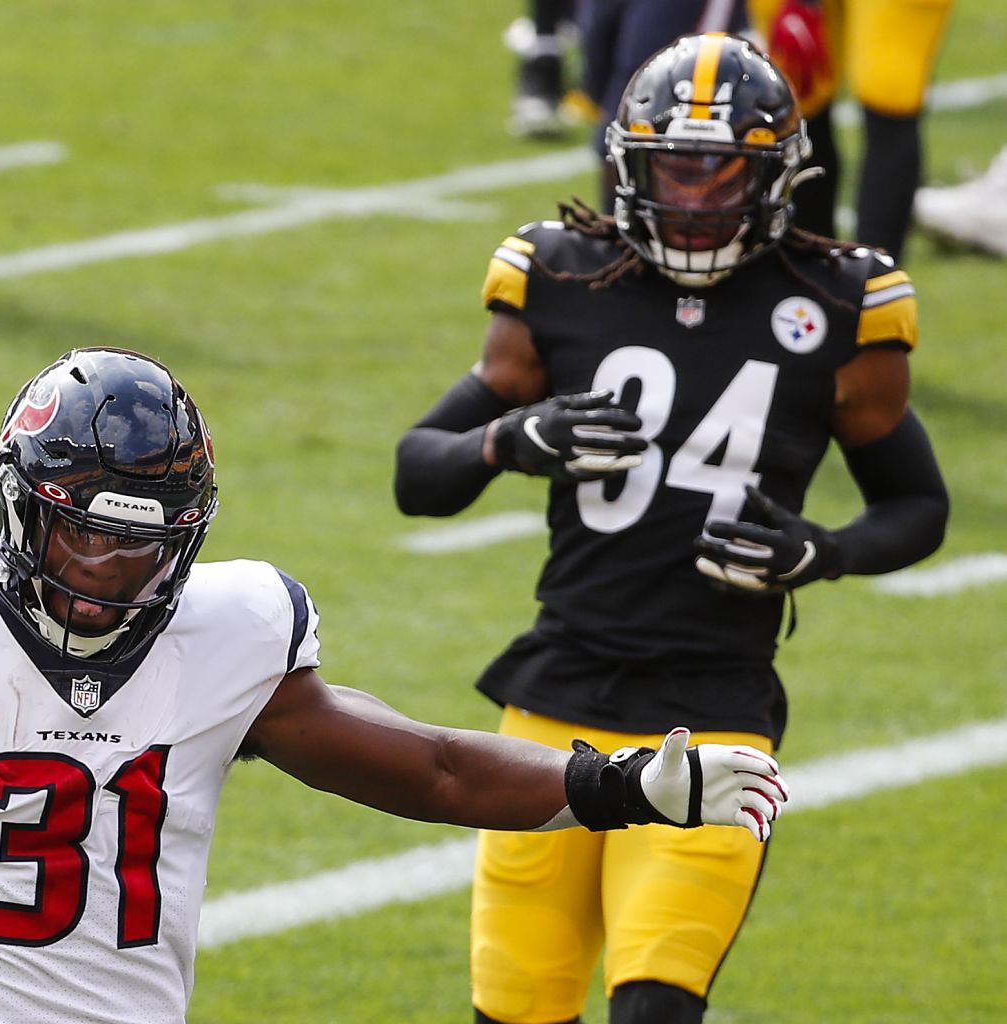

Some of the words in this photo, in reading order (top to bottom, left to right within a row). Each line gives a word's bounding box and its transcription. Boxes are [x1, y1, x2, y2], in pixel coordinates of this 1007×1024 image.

[576, 345, 780, 541] 34
[104, 498, 156, 512] TEXANS
[75, 691, 97, 706] NFL
[36, 729, 123, 744] TEXANS
